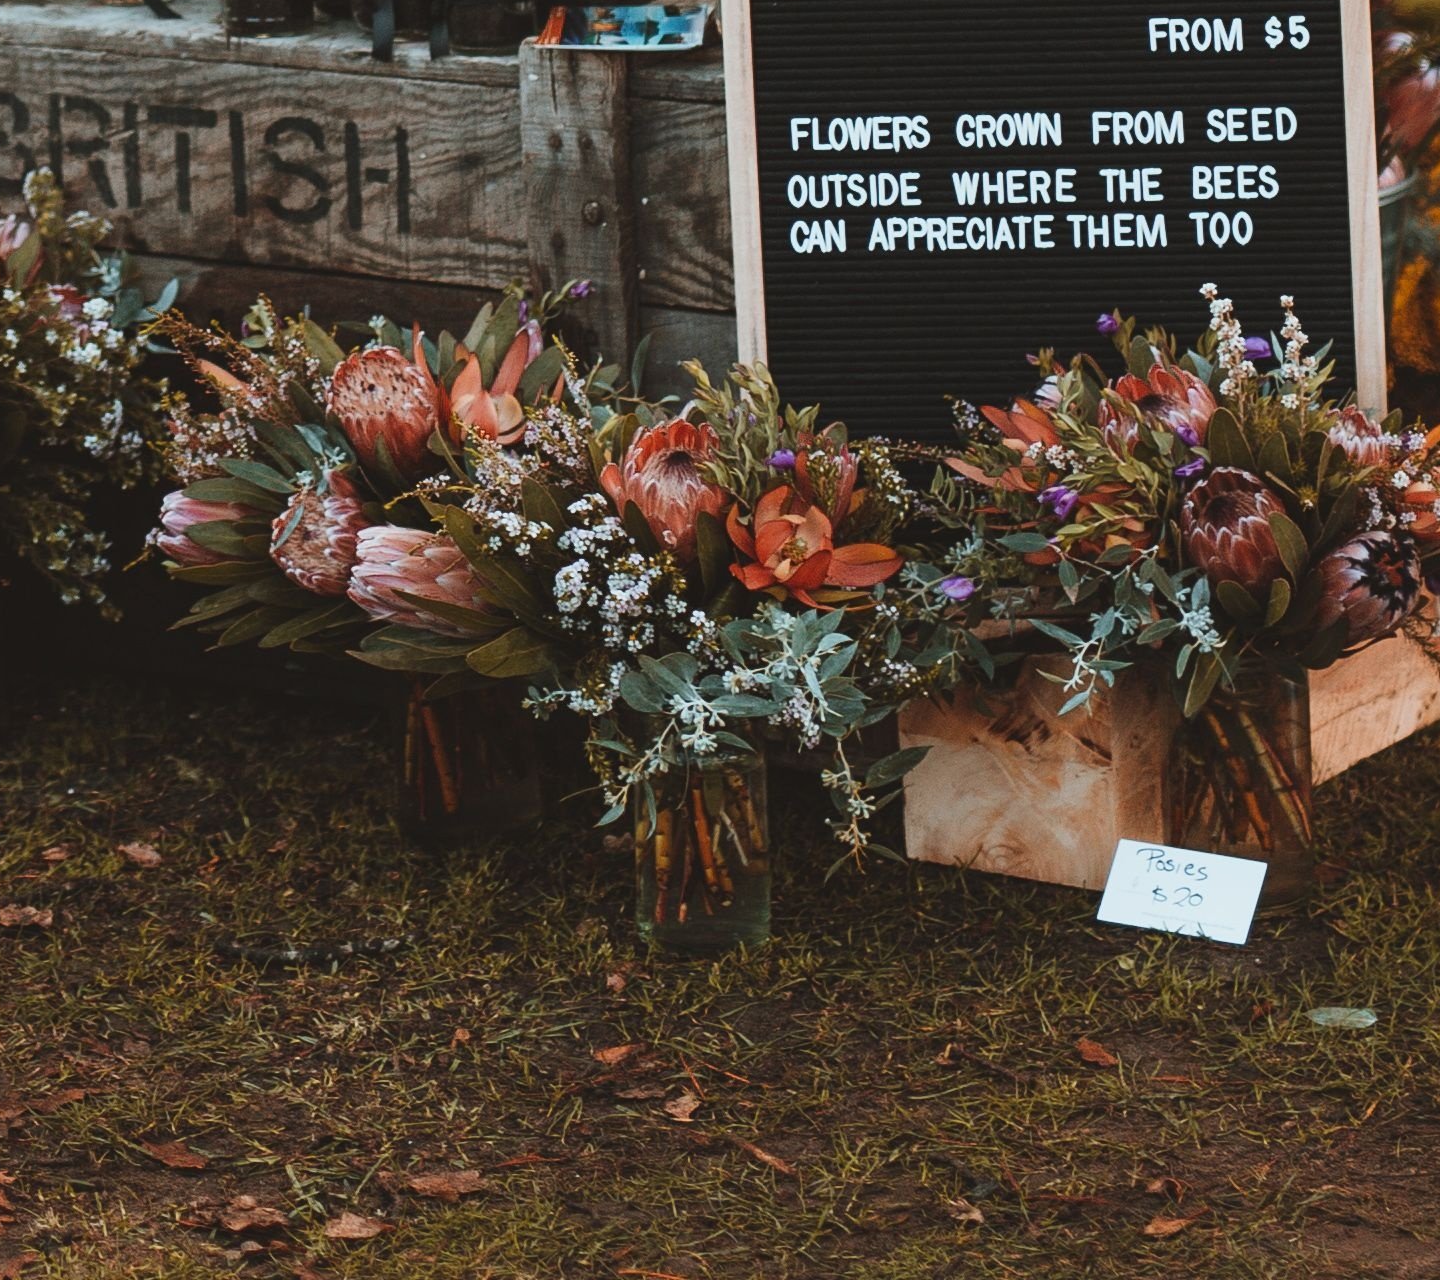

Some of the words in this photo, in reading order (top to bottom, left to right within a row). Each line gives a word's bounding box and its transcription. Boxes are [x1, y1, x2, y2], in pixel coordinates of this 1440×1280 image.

[1147, 16, 1245, 54] FROM
[1263, 14, 1311, 51] $5
[789, 113, 932, 154] FLOWERS
[954, 111, 1064, 150] GROWN
[1090, 109, 1186, 147] FROM
[1205, 105, 1299, 144] SEED
[786, 170, 923, 210] OUTSIDE
[950, 167, 1078, 207] WHERE
[1098, 166, 1165, 204] THE
[1191, 163, 1281, 201] BEES
[789, 218, 848, 255] CAN
[867, 213, 1057, 253] APPRECIATE
[1065, 212, 1169, 250] THEM
[1187, 210, 1255, 250] TOO
[1135, 847, 1209, 882] Posies
